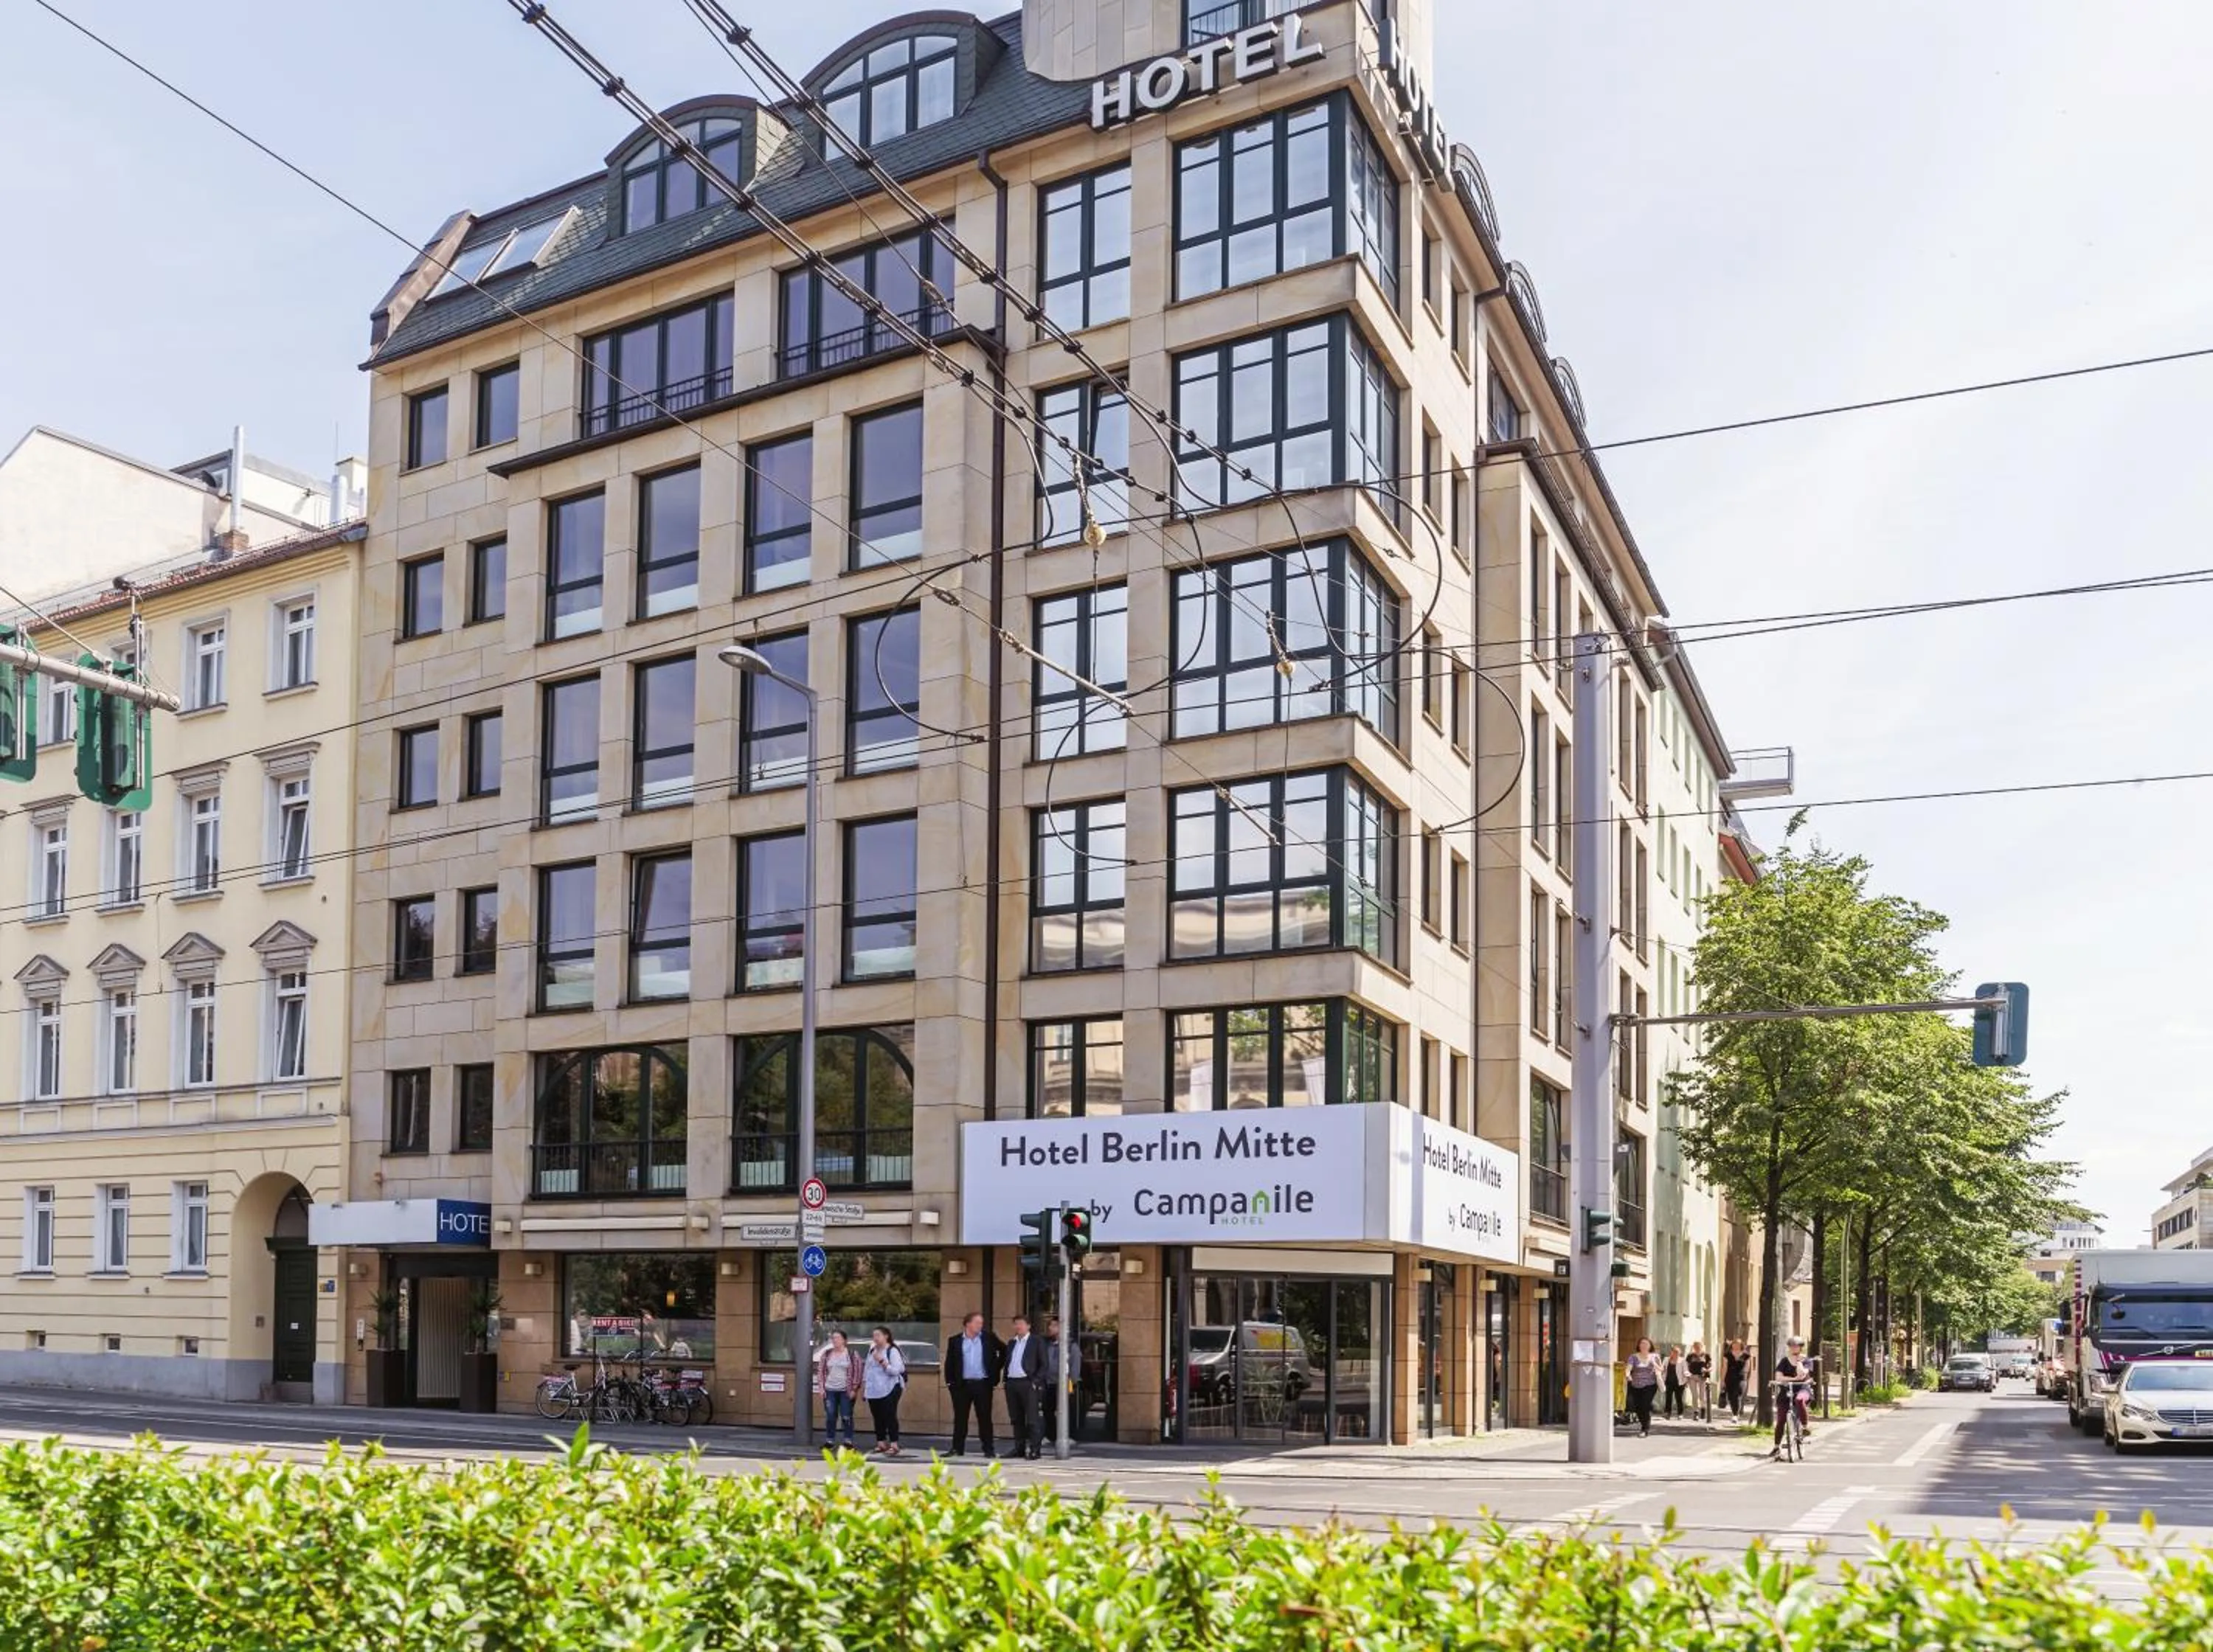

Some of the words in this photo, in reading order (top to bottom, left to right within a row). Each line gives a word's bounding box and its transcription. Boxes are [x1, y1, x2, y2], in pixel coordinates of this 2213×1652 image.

[1091, 13, 1326, 131] HOTEL
[1000, 1128, 1088, 1167] Hotel
[1102, 1128, 1201, 1164] Berlin
[1214, 1125, 1316, 1159] Mitte
[1423, 1133, 1450, 1171] Hotel
[1452, 1144, 1478, 1181] Berlin
[1479, 1156, 1501, 1190] Mitte
[807, 1187, 821, 1201] 30
[1090, 1198, 1112, 1224] by
[1134, 1184, 1314, 1225] Campanile
[440, 1212, 491, 1234] HOTE
[1221, 1216, 1264, 1226] HOTEL
